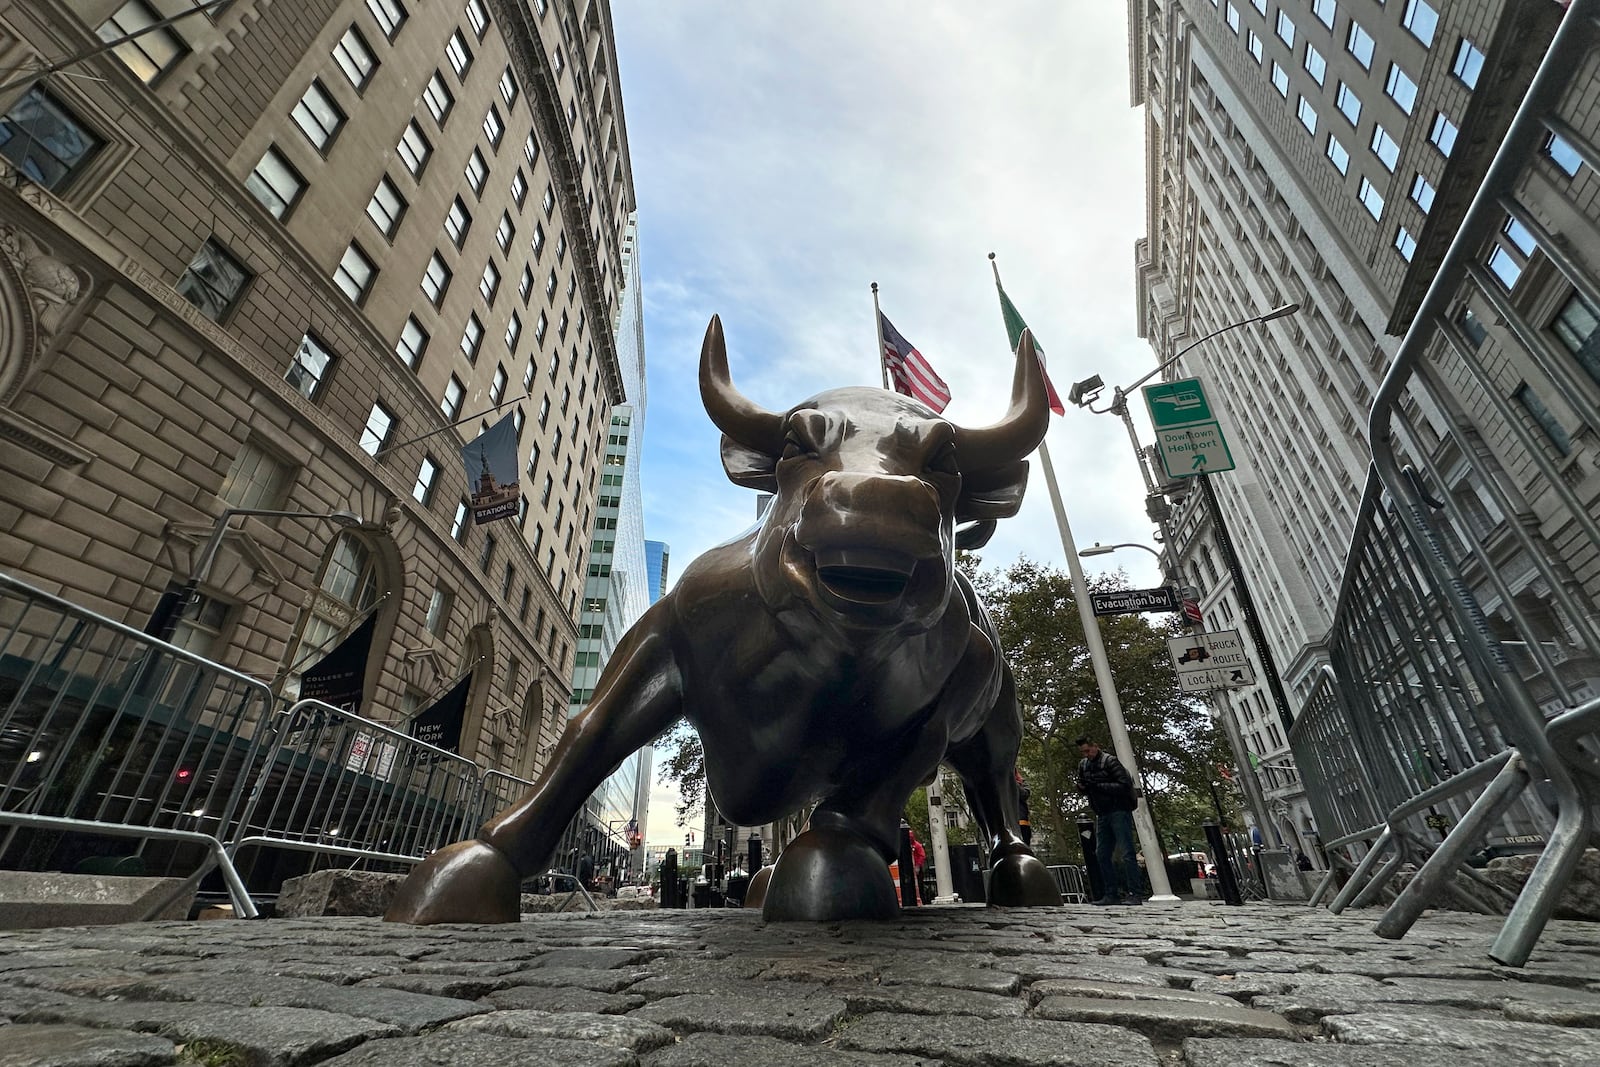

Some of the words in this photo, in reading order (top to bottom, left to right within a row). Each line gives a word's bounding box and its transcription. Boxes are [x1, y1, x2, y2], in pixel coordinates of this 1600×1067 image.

[1164, 430, 1214, 442] Downtown
[1168, 440, 1217, 453] Heliport
[476, 504, 507, 517] STATION
[1096, 598, 1148, 609] Evacuation
[1148, 595, 1167, 605] Day
[1208, 639, 1237, 651] TRUCK
[1212, 653, 1243, 665] ROUTE
[1187, 674, 1218, 686] LOCAL
[420, 724, 442, 733] NEW
[418, 732, 443, 741] YORK
